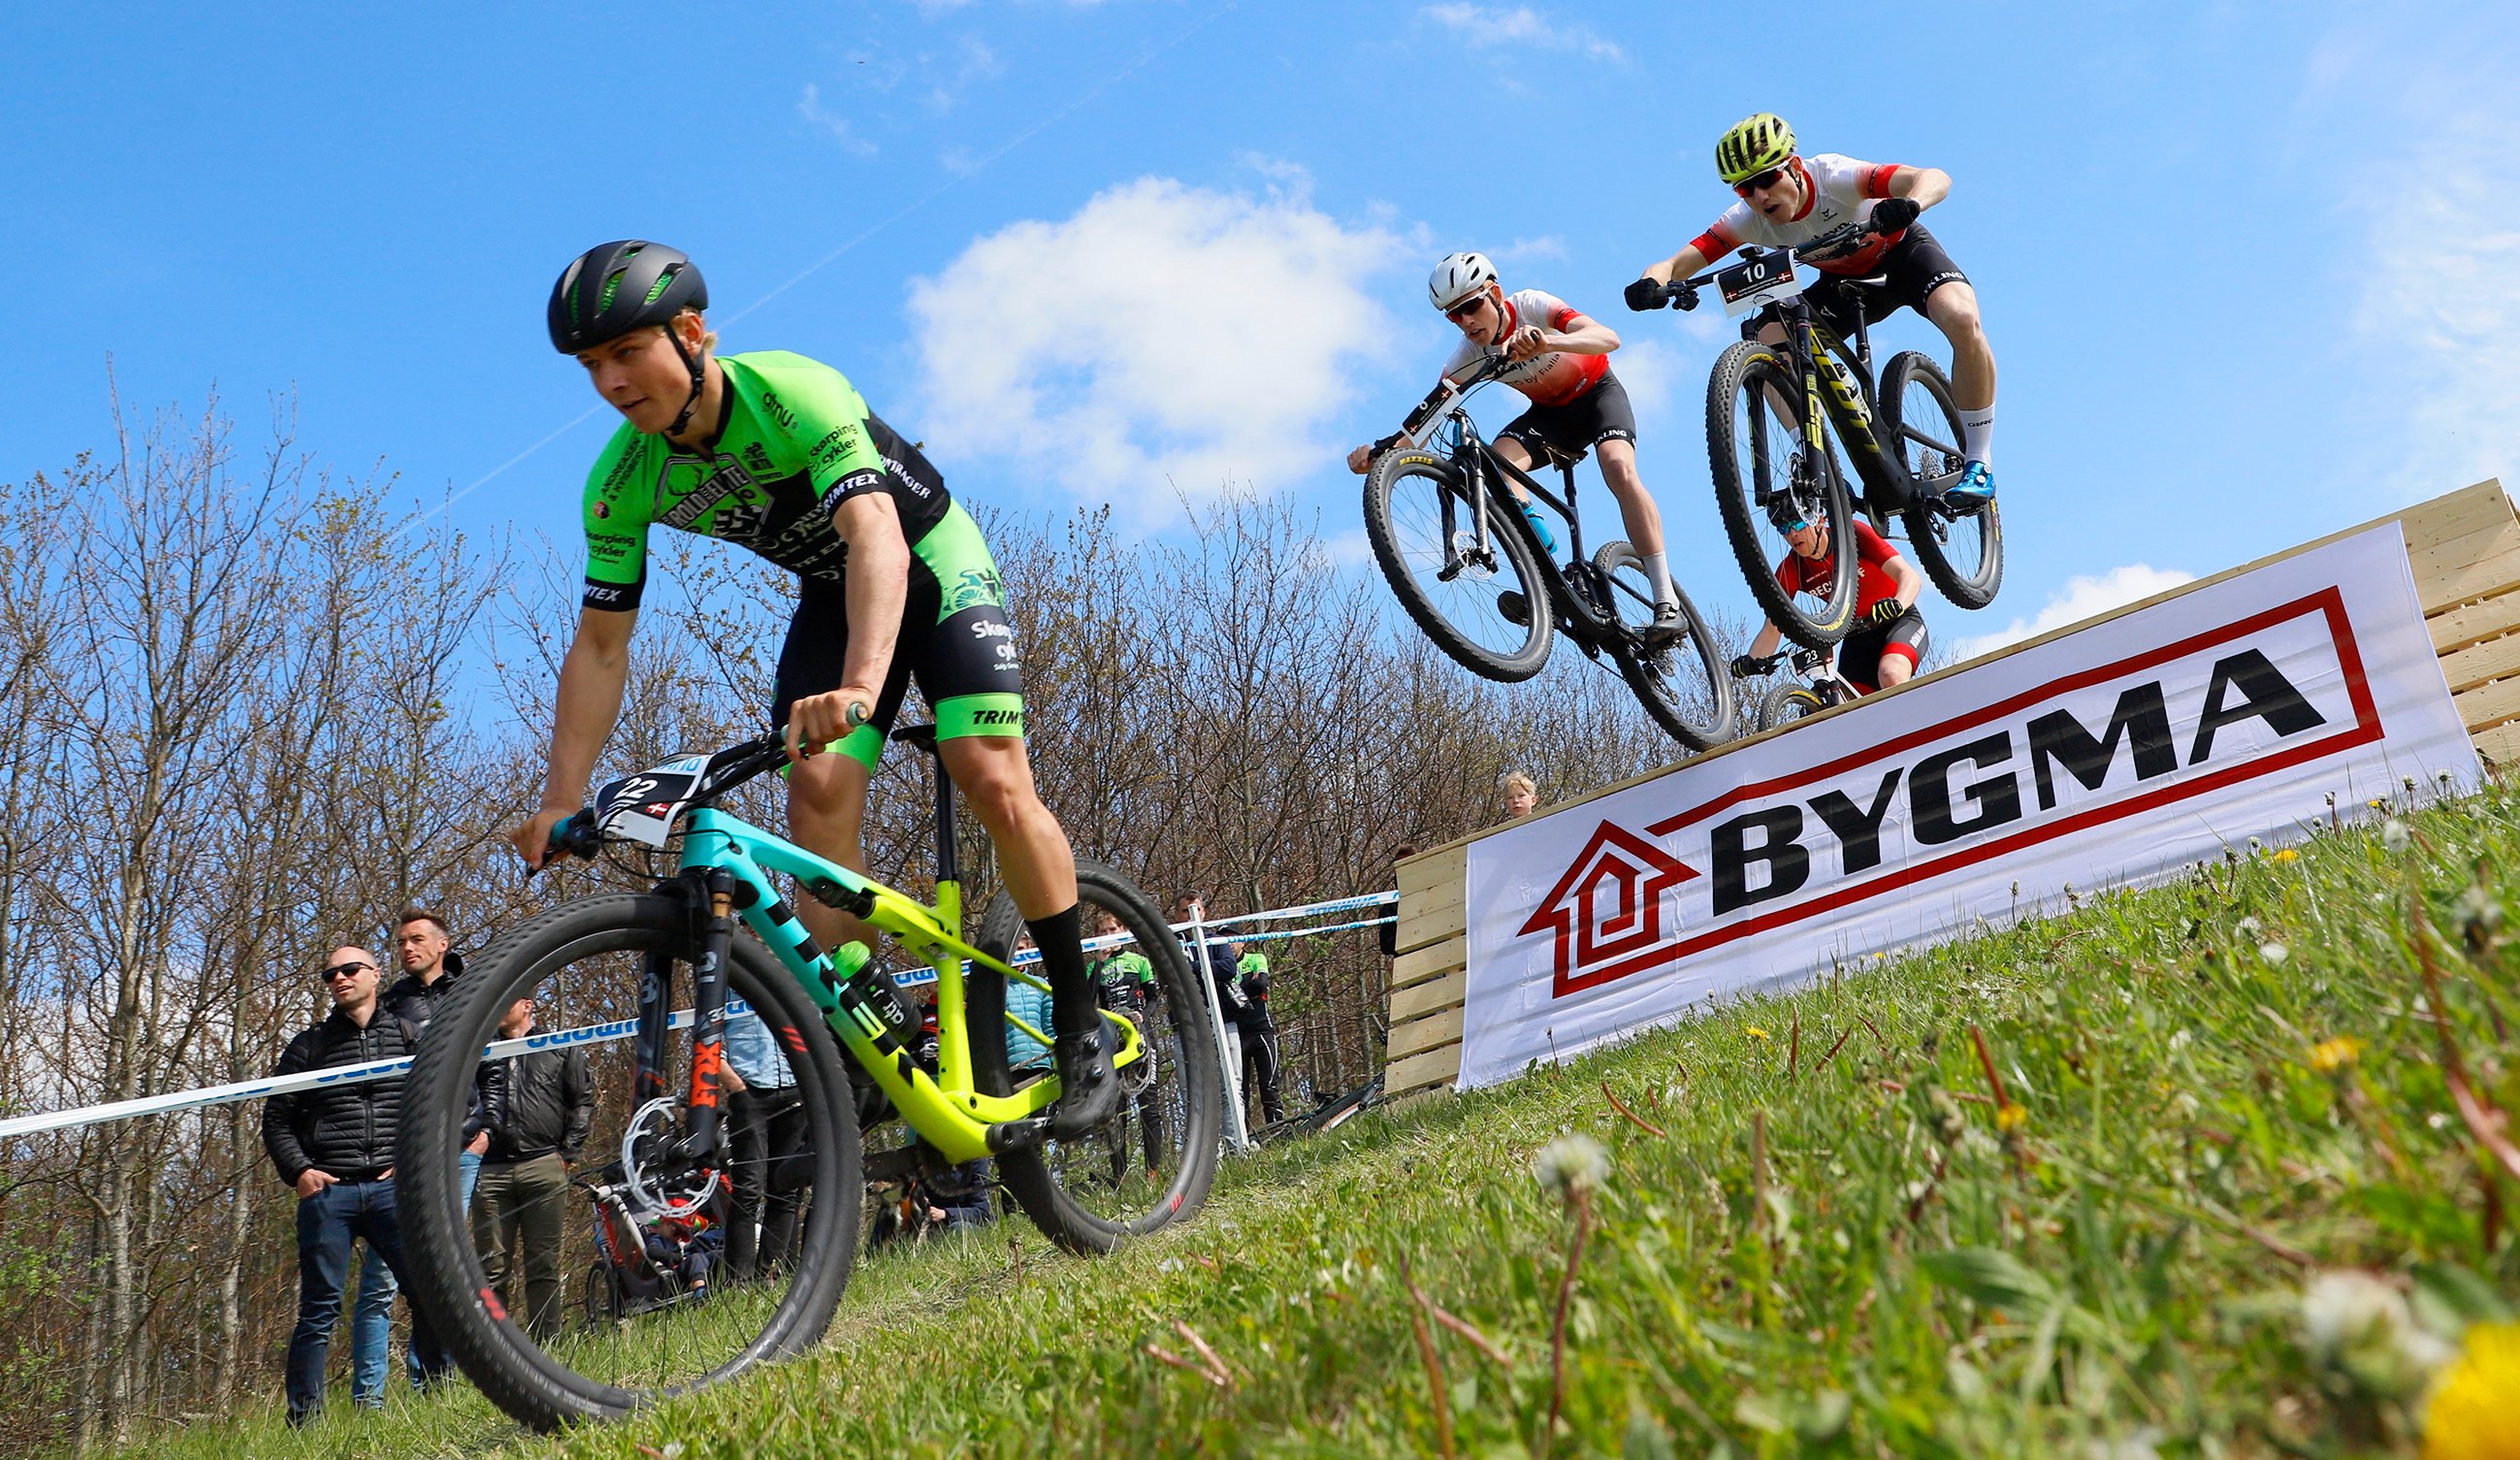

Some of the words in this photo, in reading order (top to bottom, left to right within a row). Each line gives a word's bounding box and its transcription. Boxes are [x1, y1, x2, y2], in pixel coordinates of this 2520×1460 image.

[1742, 263, 1765, 283] 10
[1925, 271, 1965, 292] YKLING
[1400, 455, 1434, 466] MAXXIS
[880, 455, 932, 500] ONTRAGER
[824, 472, 879, 513] RIMTEX
[583, 584, 623, 602] MTEX
[1804, 650, 1819, 665] 23
[973, 710, 1024, 726] TRIM
[613, 776, 659, 800] 22
[1712, 649, 2328, 917] BYGMA
[690, 1040, 722, 1109] FOX
